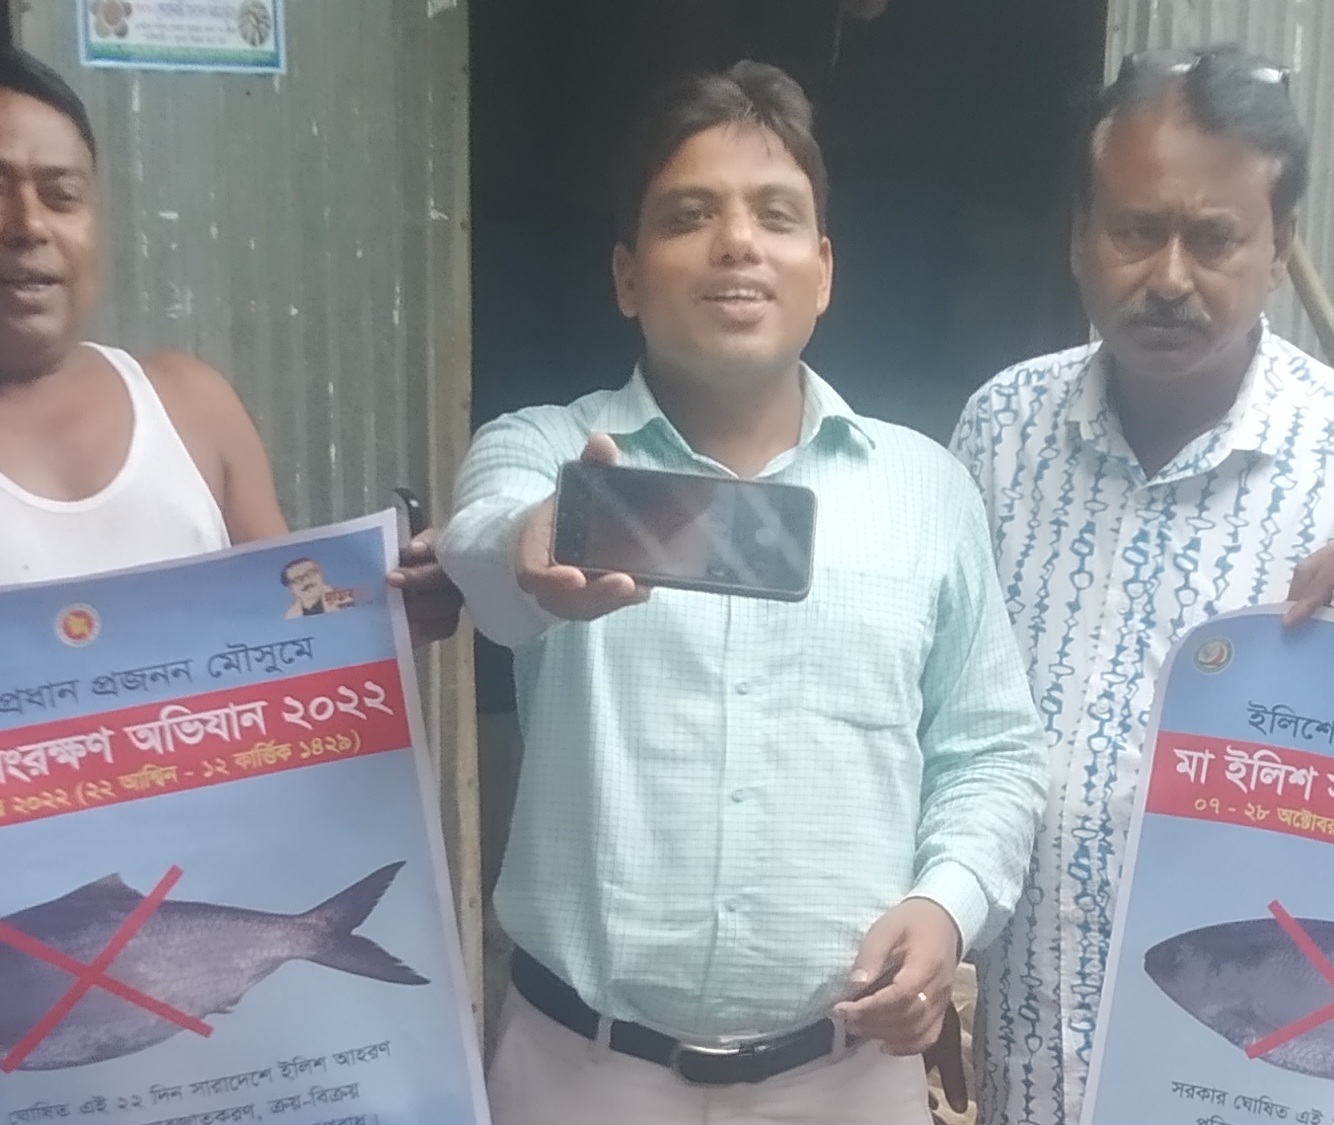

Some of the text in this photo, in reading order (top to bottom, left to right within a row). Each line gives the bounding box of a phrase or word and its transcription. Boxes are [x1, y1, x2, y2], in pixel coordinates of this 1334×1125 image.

[91, 658, 193, 696] প্রজনন
[207, 636, 314, 678] মৌসুমে
[122, 700, 268, 754] অভিযান
[282, 680, 393, 730] ২০২২
[1172, 748, 1215, 784] মা
[1223, 744, 1319, 800] ইলিশ
[1194, 797, 1221, 816] ০৭
[1243, 803, 1271, 822] ২৮
[1171, 1080, 1228, 1105] সরকার
[1233, 1094, 1290, 1119] ঘোষিত
